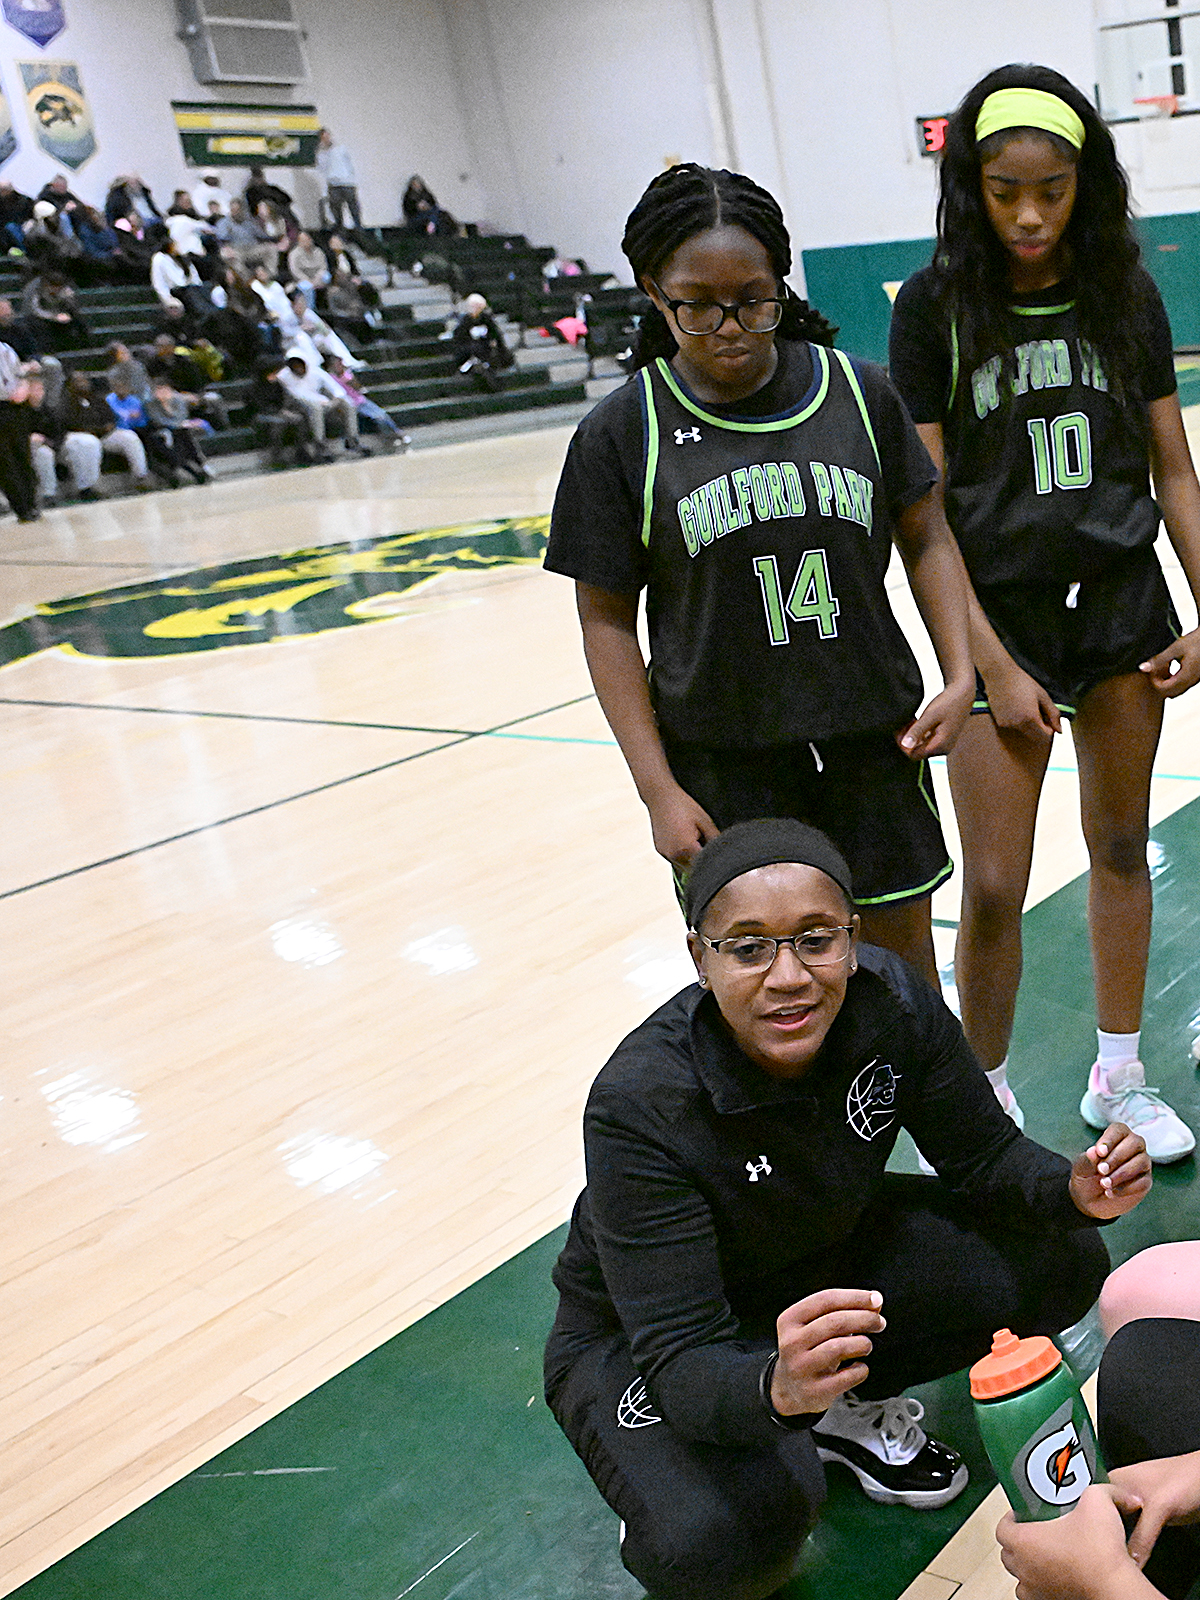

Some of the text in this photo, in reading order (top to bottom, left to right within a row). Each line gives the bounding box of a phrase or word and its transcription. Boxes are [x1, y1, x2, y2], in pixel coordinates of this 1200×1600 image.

[923, 118, 949, 152] 3
[1027, 411, 1093, 494] 10
[677, 461, 874, 558] GUILFORD PARK
[752, 548, 841, 646] 14
[1025, 1420, 1093, 1506] G
